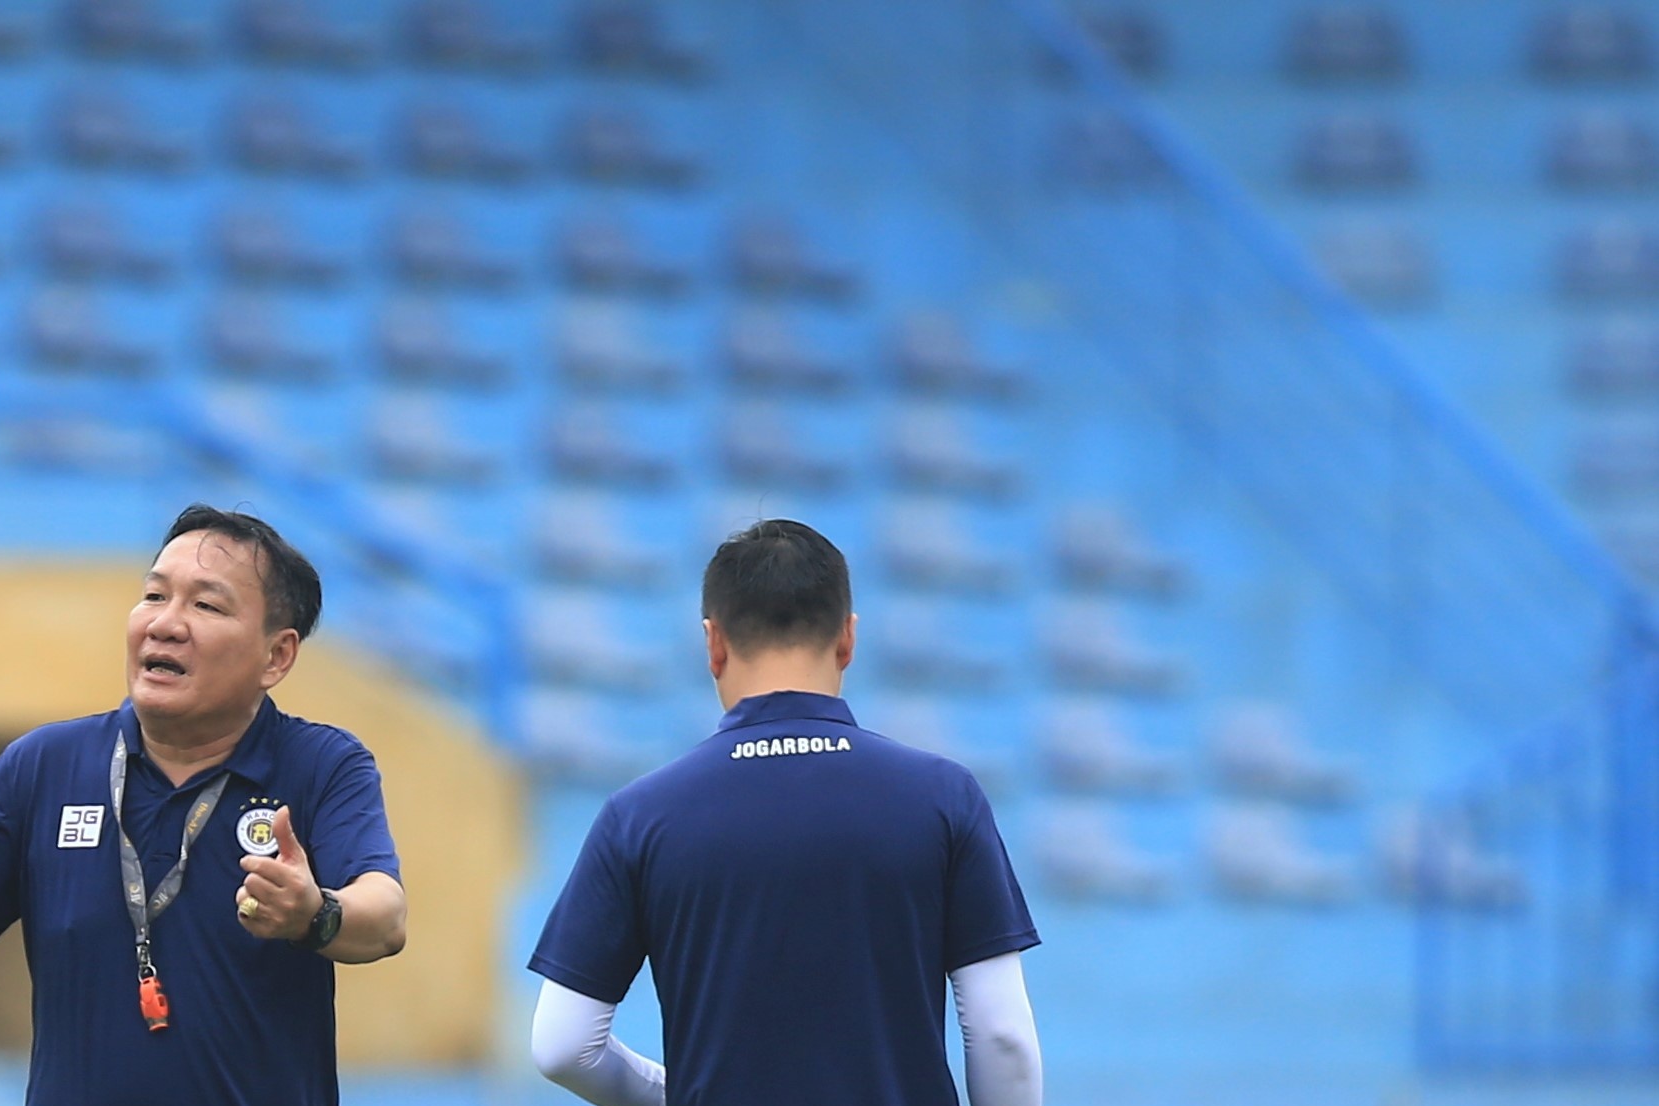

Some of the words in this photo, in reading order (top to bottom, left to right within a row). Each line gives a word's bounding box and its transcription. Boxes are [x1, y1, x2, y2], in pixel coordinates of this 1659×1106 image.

[731, 737, 851, 759] JOGARBOLA
[65, 810, 99, 824] JG
[246, 811, 276, 822] HANO
[63, 828, 95, 843] BL
